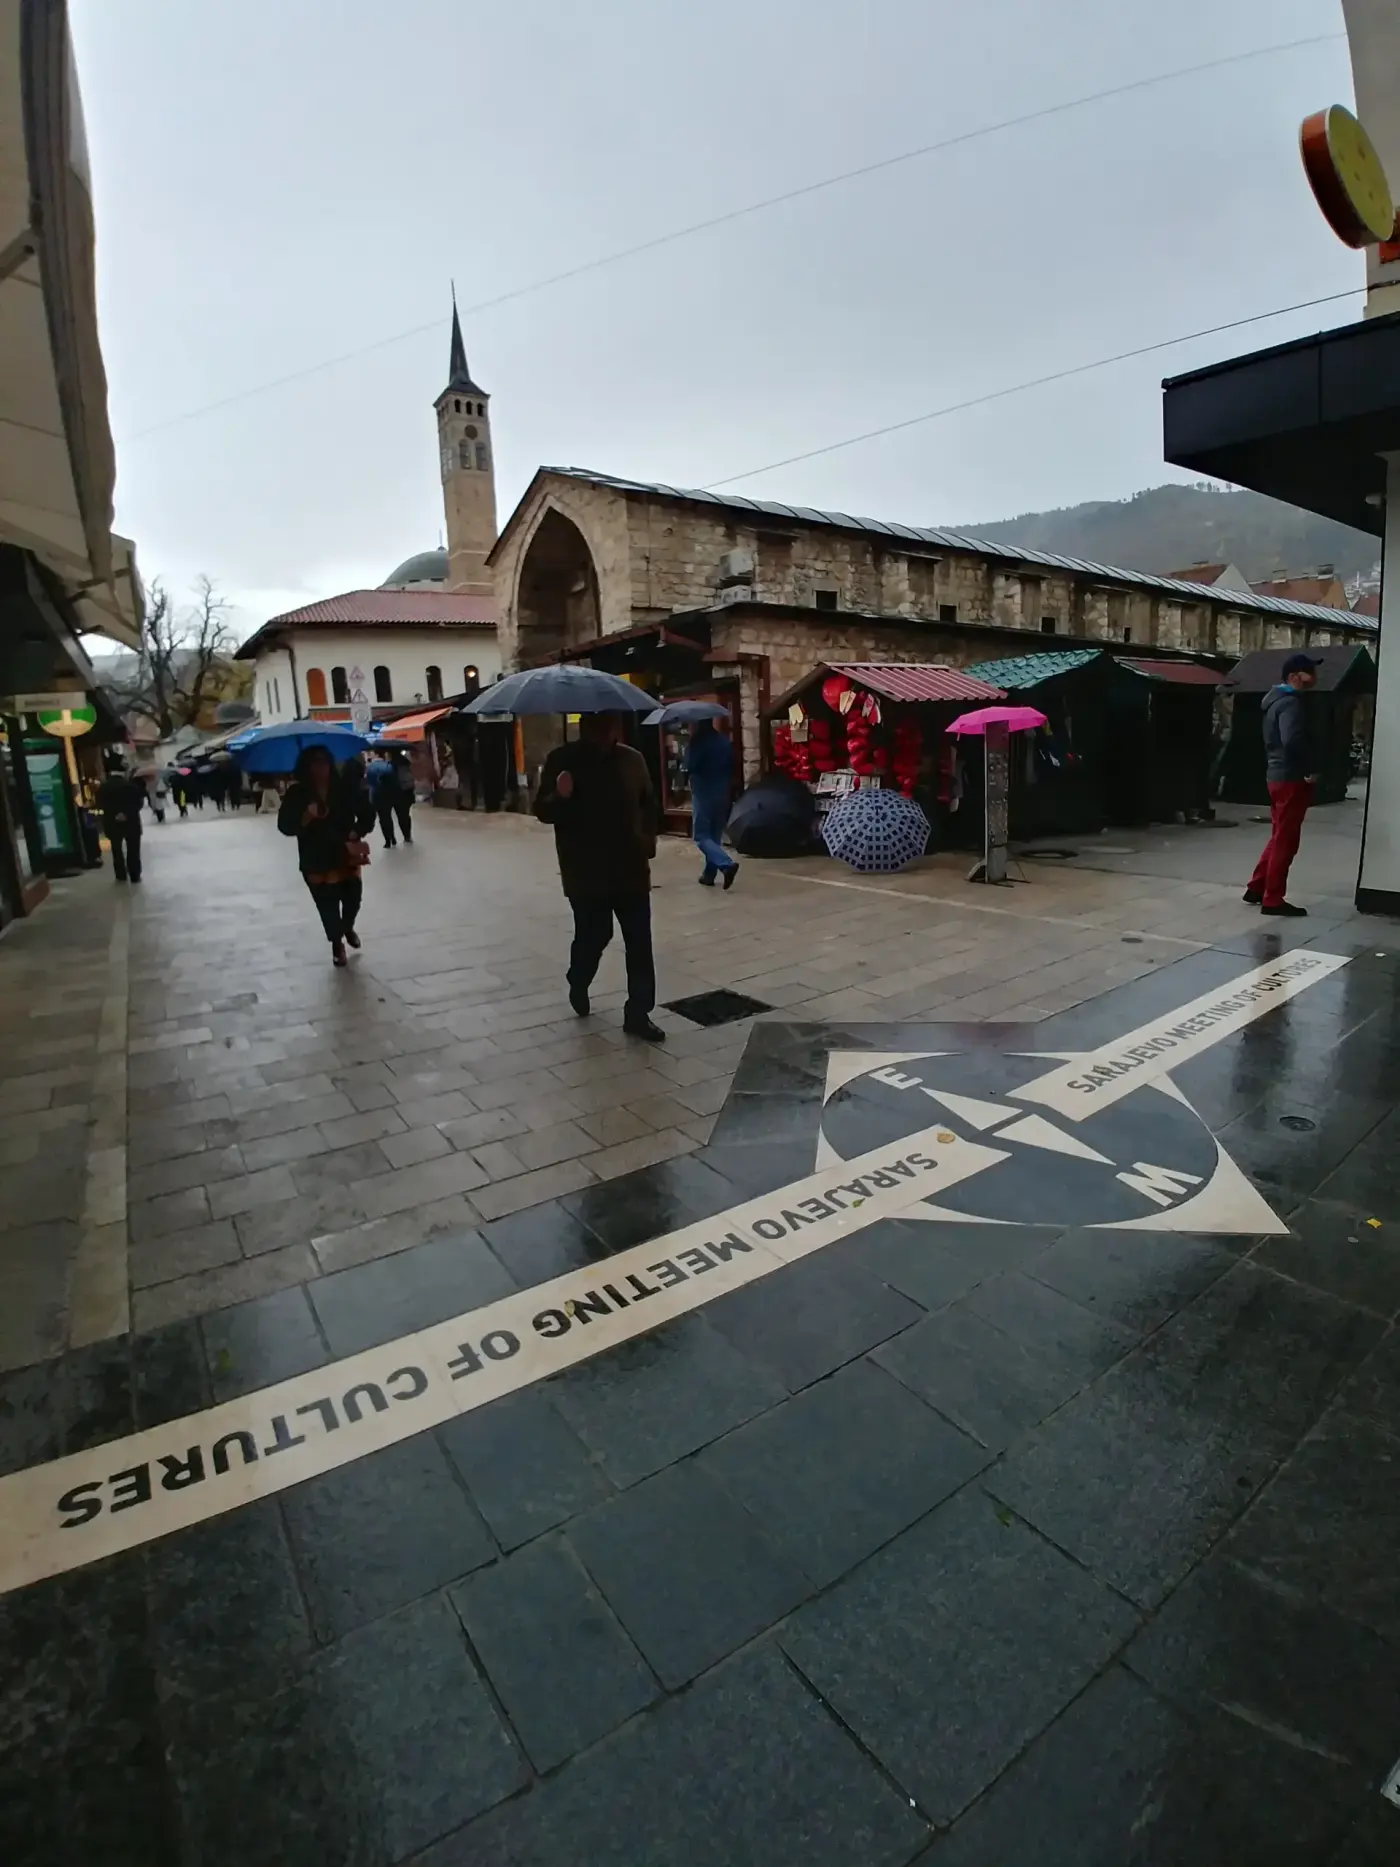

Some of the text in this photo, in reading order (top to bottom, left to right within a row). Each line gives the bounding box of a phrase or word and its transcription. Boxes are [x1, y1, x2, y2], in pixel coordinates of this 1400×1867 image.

[868, 1067, 922, 1090] E
[1067, 1036, 1173, 1093] SARAJEVO
[1171, 999, 1245, 1040] MEETING
[1233, 989, 1262, 1002] OF
[1115, 1161, 1204, 1207] W
[57, 1153, 938, 1528] SARAJEVO MEETING OF CULTURES
